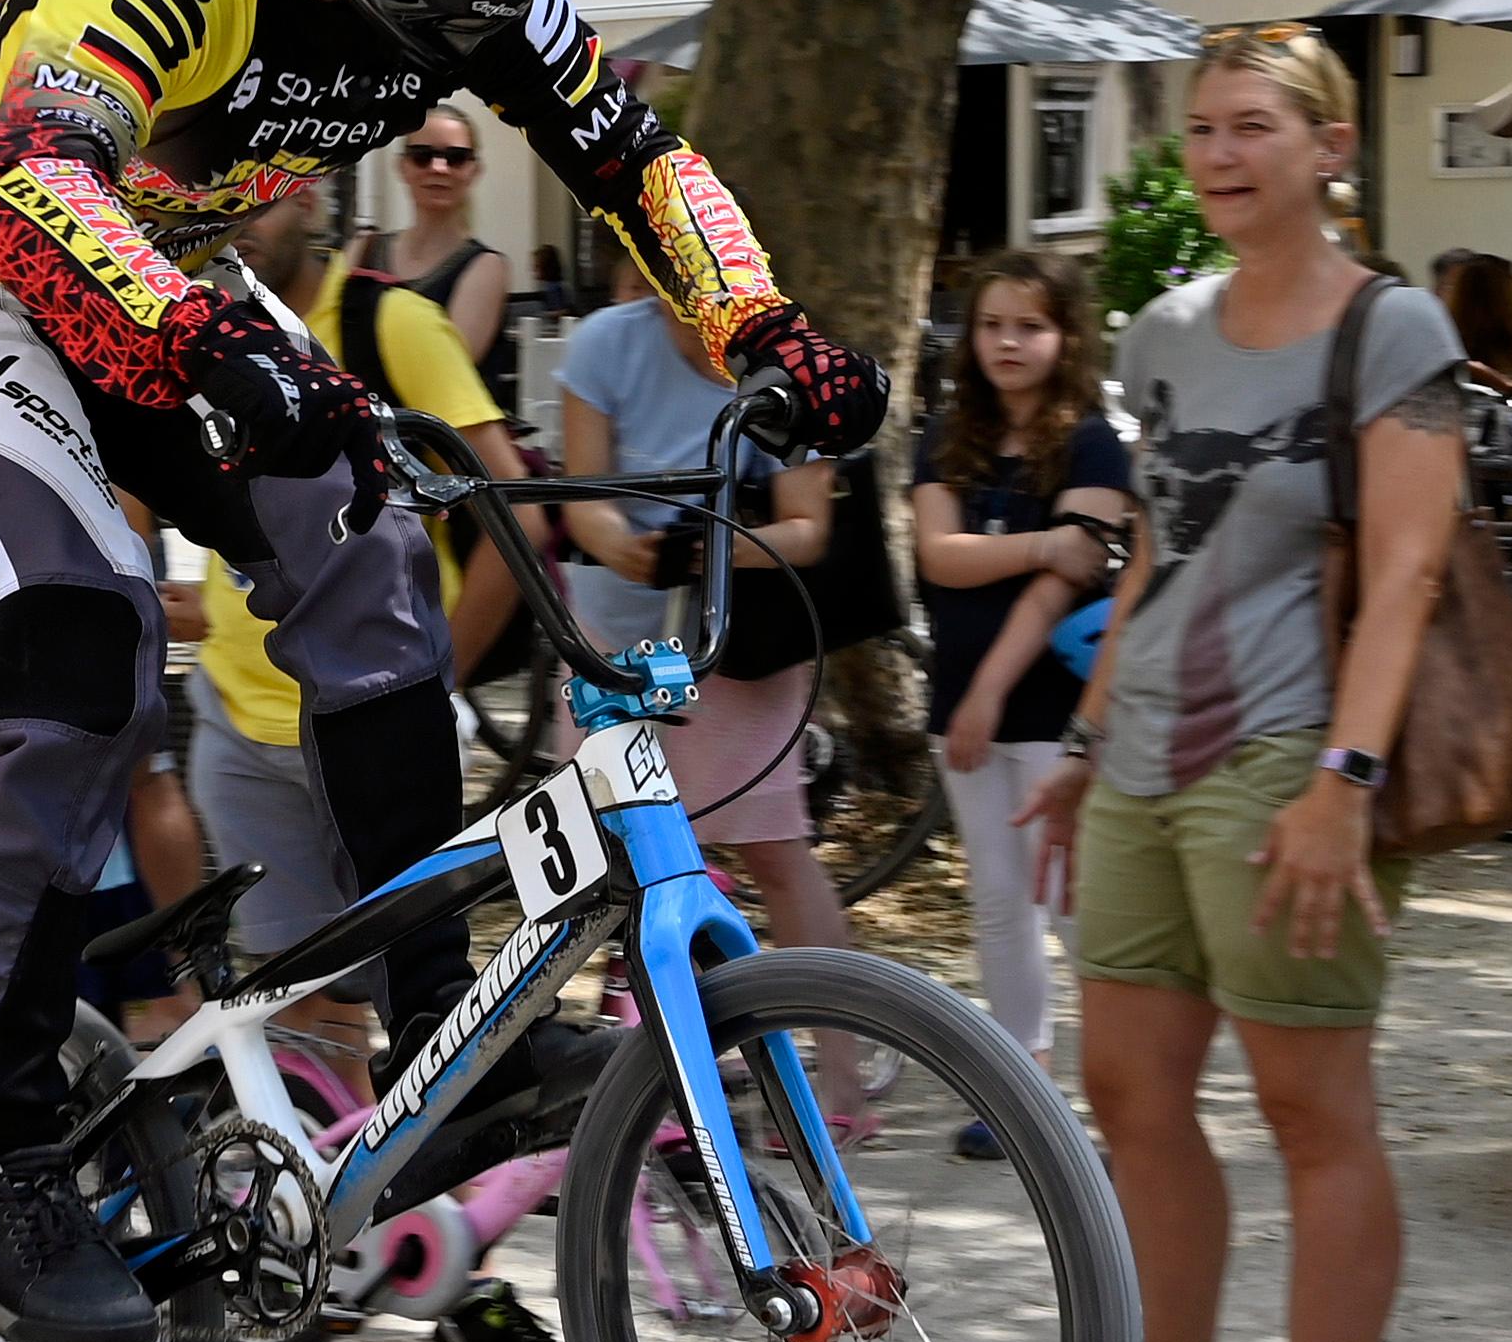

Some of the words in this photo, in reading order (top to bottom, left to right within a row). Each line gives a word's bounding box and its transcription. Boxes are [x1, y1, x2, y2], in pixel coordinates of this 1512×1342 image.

[34, 64, 101, 97] MJ
[571, 93, 622, 151] MJ
[0, 177, 82, 248] BMX
[83, 245, 158, 321] TEA
[19, 157, 192, 302] ERLANG
[673, 152, 774, 297] LANGEN
[20, 411, 65, 446] BMX
[524, 789, 579, 897] 3
